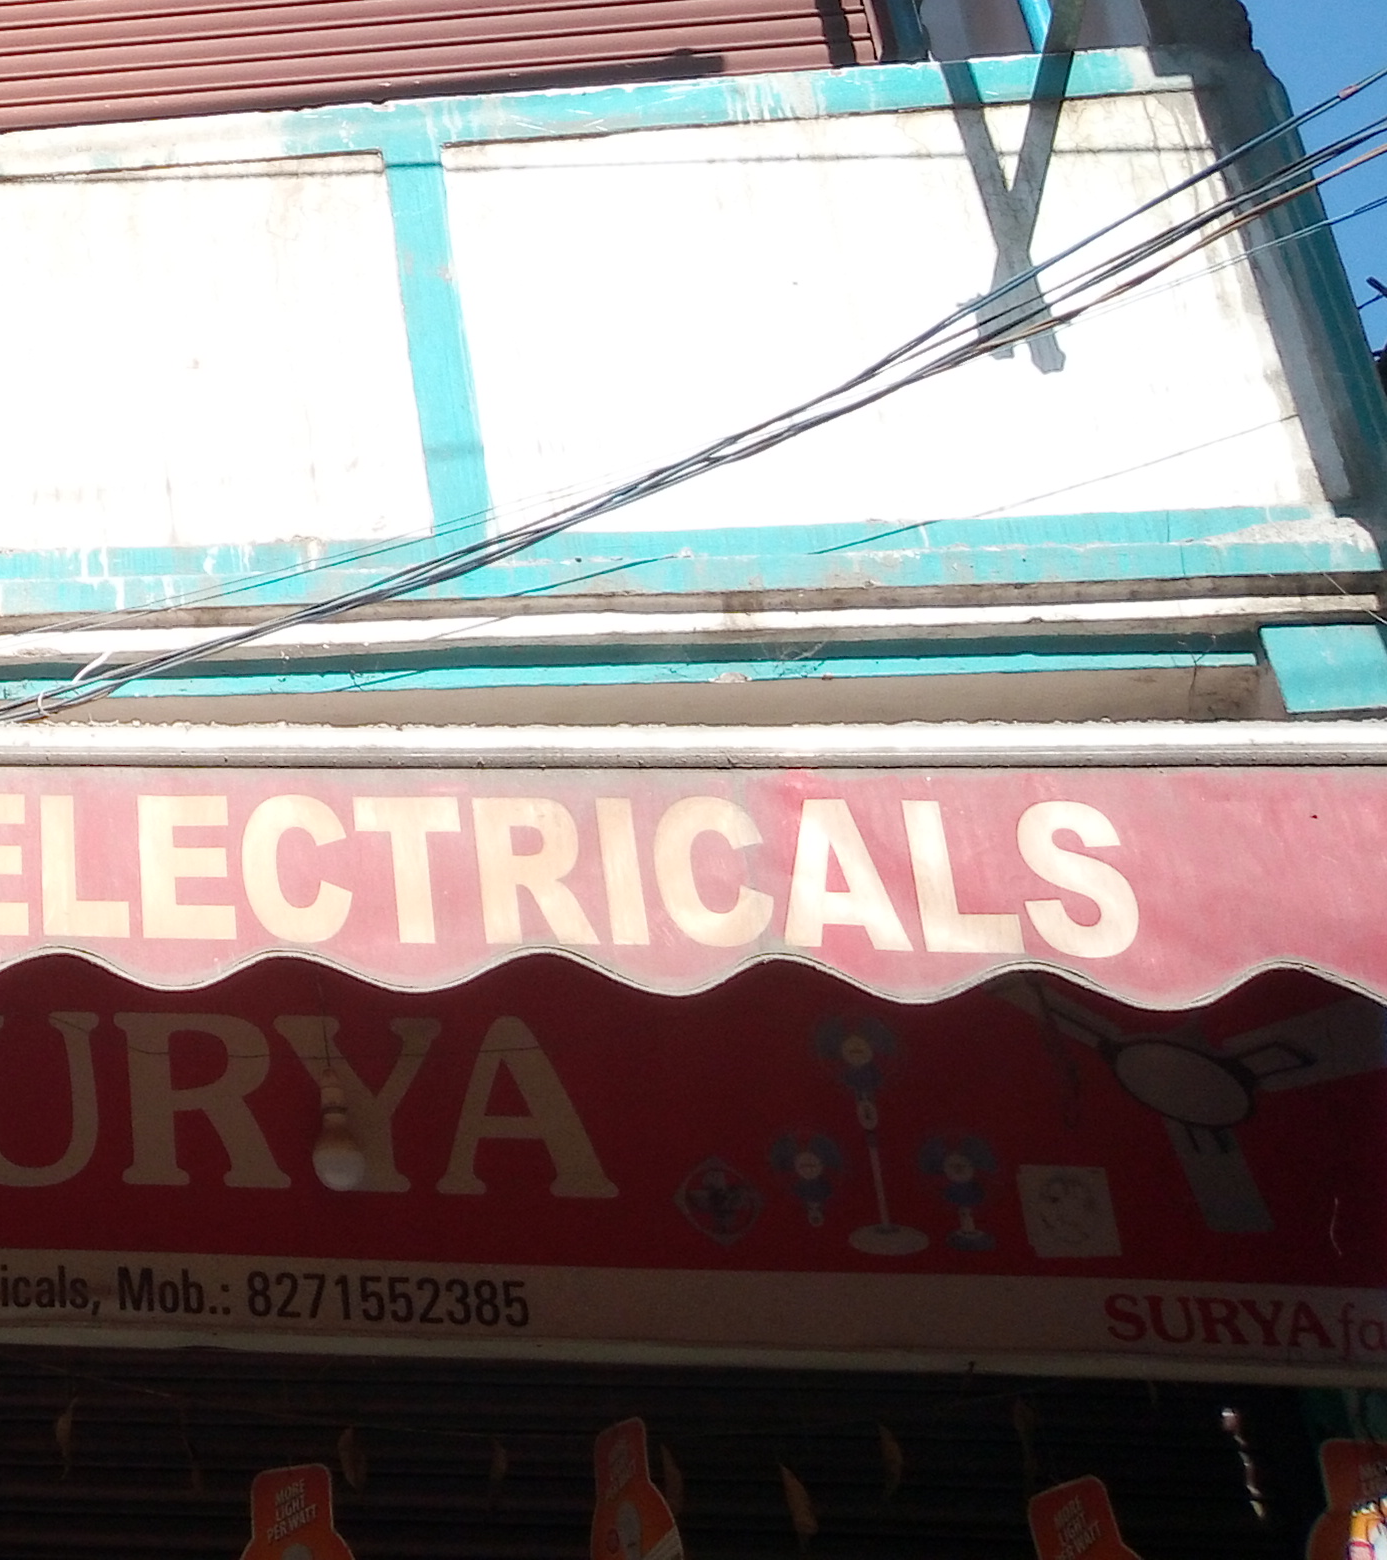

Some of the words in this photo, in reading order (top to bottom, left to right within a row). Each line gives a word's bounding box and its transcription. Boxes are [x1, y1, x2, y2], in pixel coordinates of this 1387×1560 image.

[116, 1267, 233, 1317] Mob.:
[245, 1269, 531, 1330] 8271552385
[275, 1478, 306, 1506] MORE
[276, 1494, 306, 1521] LIGHT
